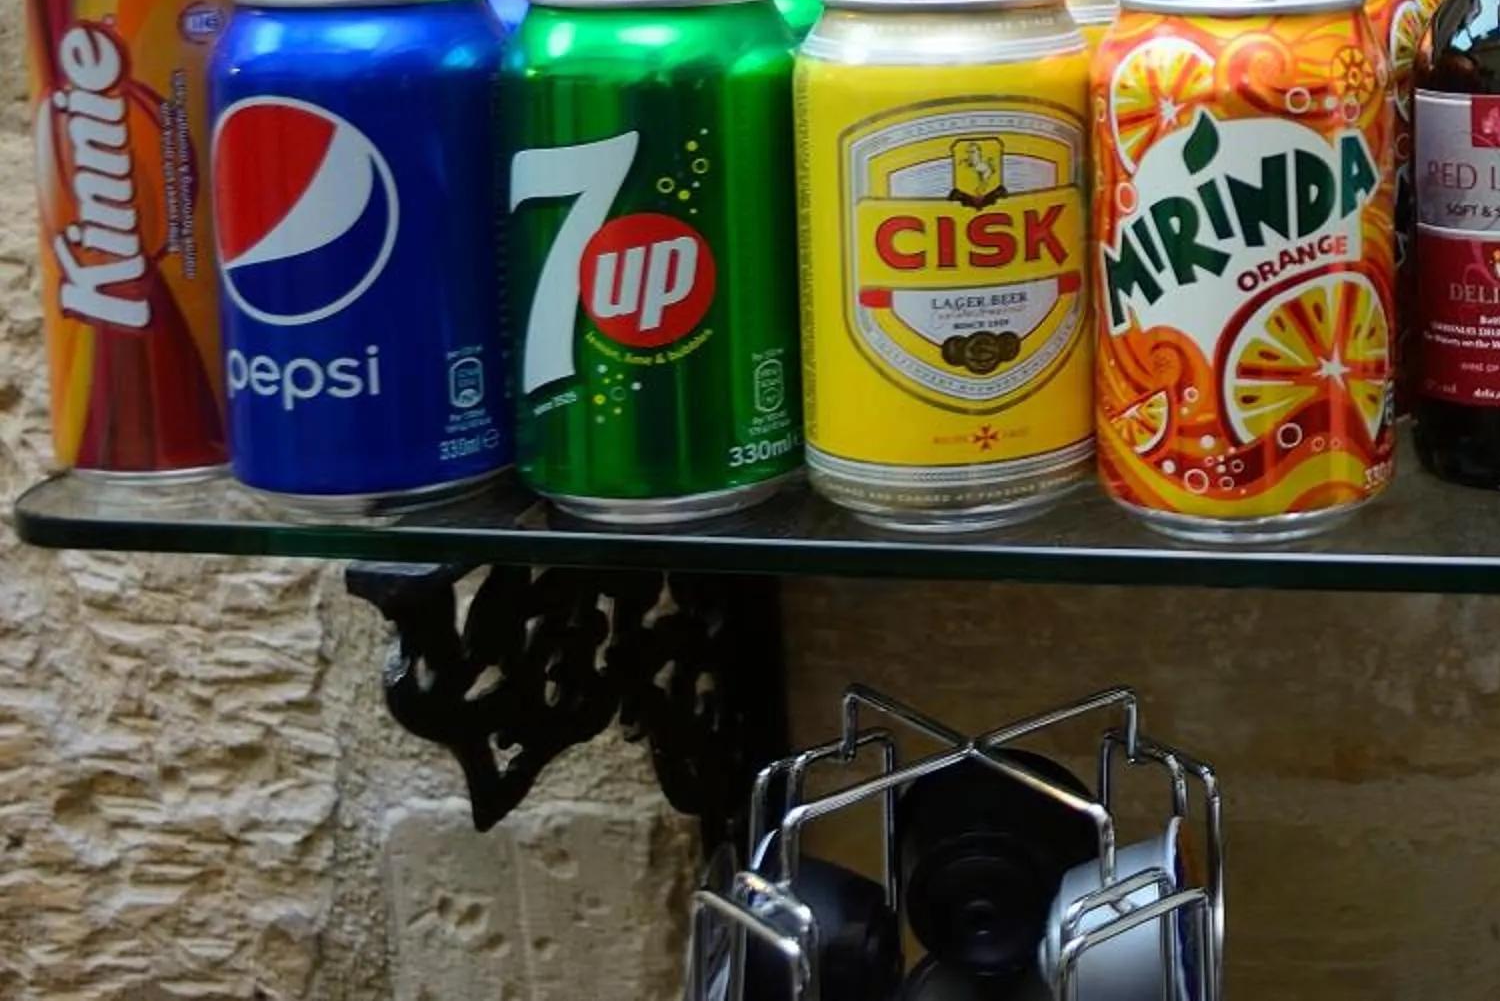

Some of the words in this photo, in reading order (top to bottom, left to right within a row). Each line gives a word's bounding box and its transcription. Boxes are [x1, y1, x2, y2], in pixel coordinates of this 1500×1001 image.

[53, 26, 151, 328] Kinnie
[1428, 161, 1477, 190] RED
[875, 204, 1069, 270] CISK
[1103, 133, 1377, 327] MIRINDA
[1446, 205, 1478, 217] SOFT
[1482, 205, 1491, 217] &
[1236, 235, 1348, 292] ORANGE
[931, 295, 986, 311] LAGER
[991, 291, 1028, 306] BEER
[227, 345, 380, 411] pepsi
[728, 432, 792, 468] 330ml
